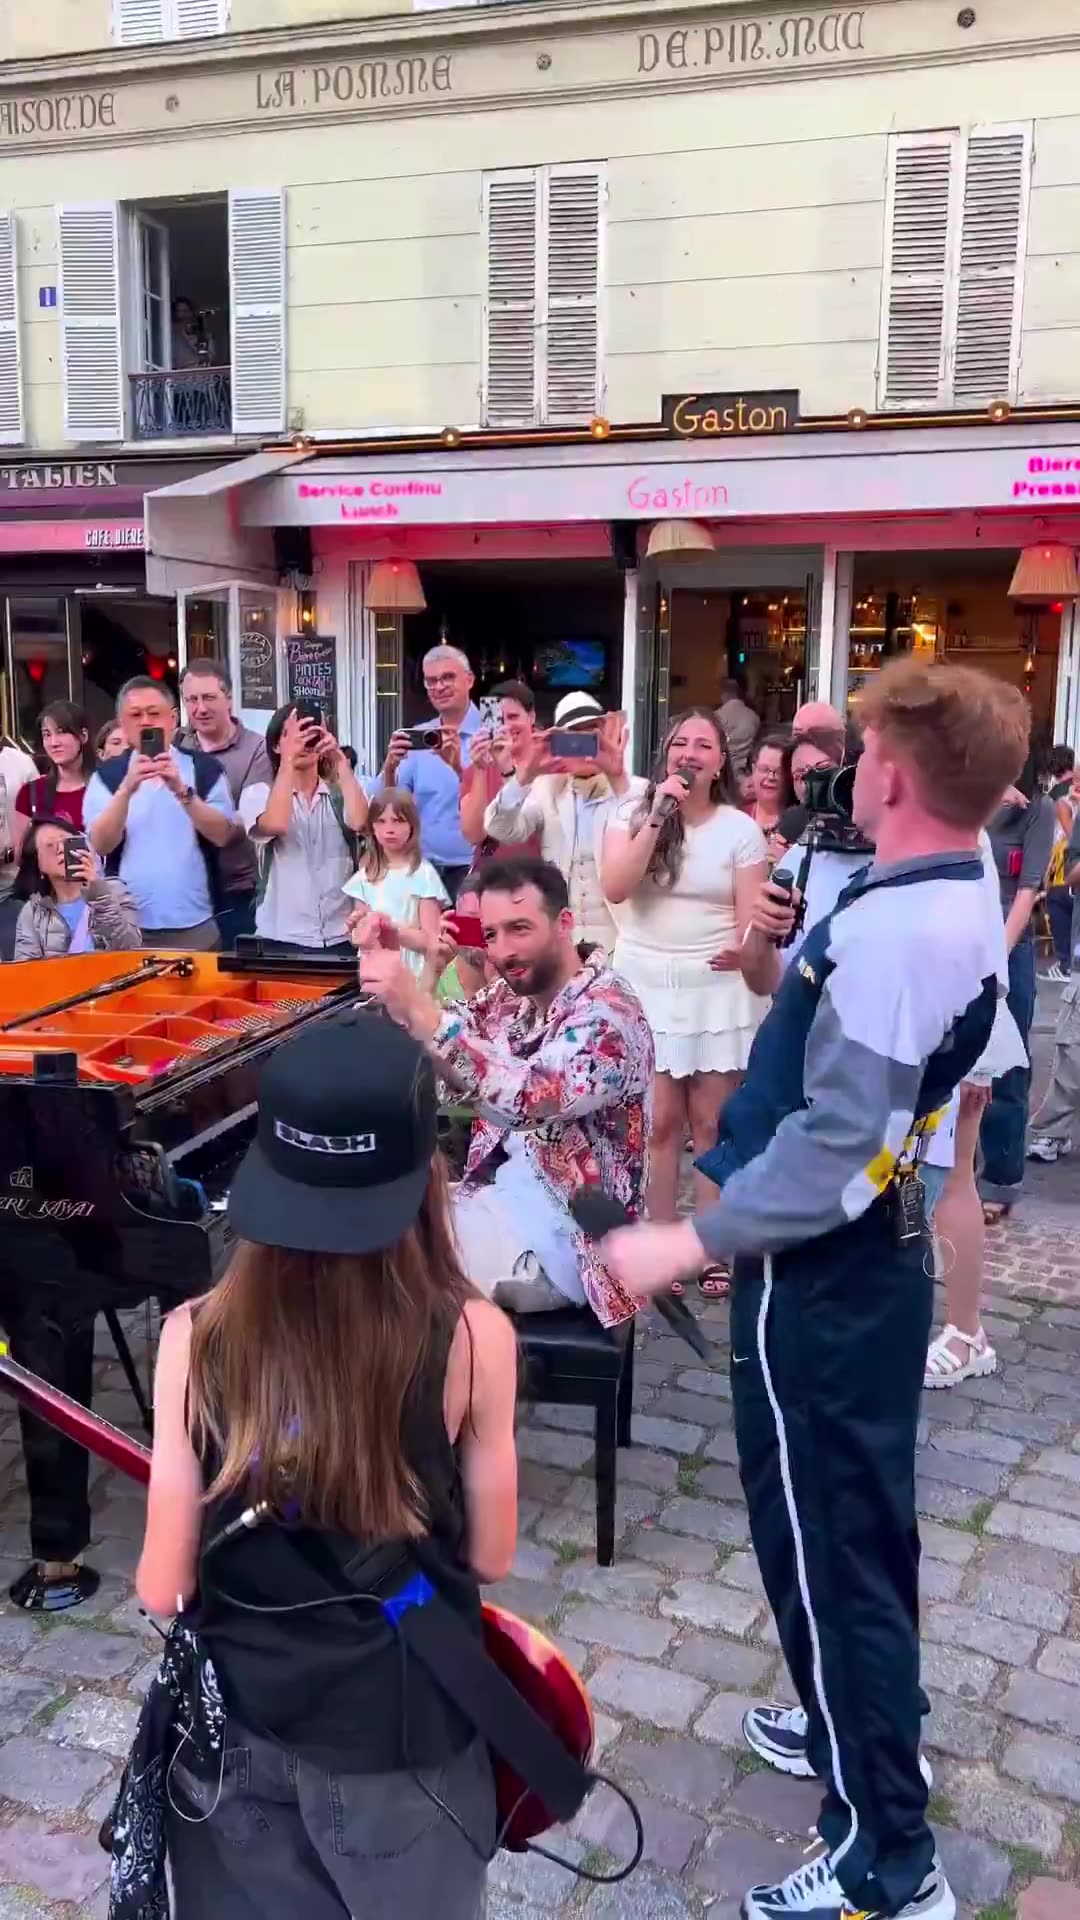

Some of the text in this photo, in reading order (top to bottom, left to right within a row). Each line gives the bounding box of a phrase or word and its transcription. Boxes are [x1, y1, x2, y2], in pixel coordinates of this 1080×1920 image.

[313, 55, 452, 103] POMME
[673, 396, 787, 434] Gaston
[2, 464, 118, 489] TALIEN
[298, 482, 442, 498] Service Continu
[626, 476, 729, 510] Gaston
[341, 502, 399, 519] Lunch
[295, 662, 332, 678] PINTES
[31, 1199, 95, 1220] KAWAI
